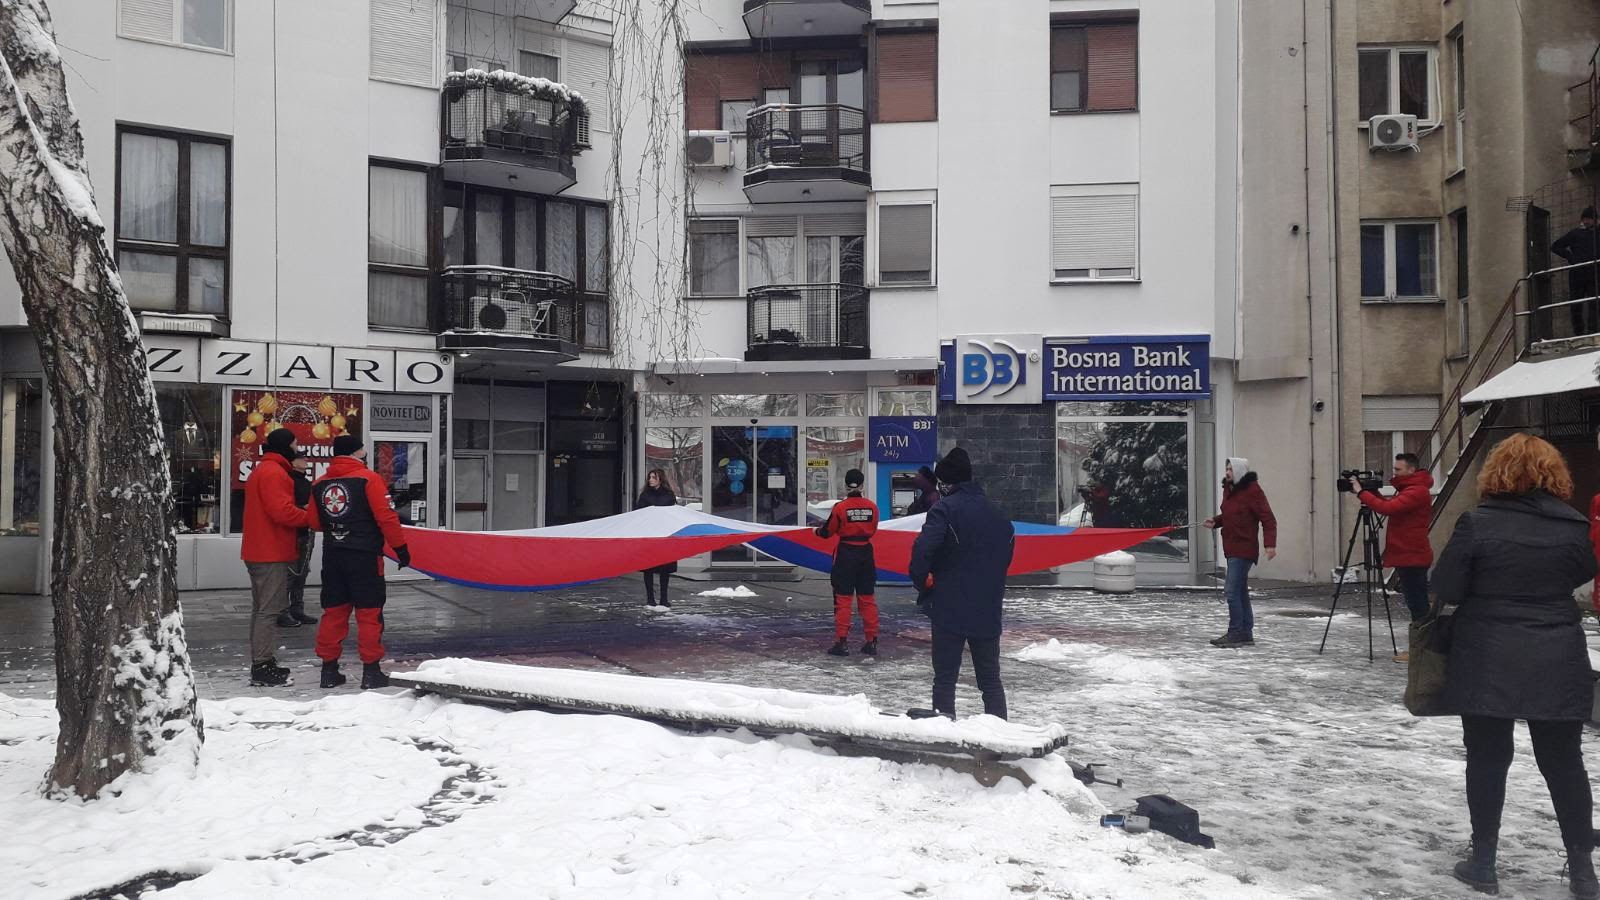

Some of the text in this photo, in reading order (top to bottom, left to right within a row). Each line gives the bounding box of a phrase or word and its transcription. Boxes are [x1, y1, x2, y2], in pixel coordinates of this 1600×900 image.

[1051, 345, 1191, 368] Bosna Bank
[146, 348, 443, 384] ZZARO
[1051, 369, 1202, 392] International
[373, 407, 430, 419] NOVITET BN
[877, 435, 908, 447] ATM
[884, 449, 899, 459] 24/7
